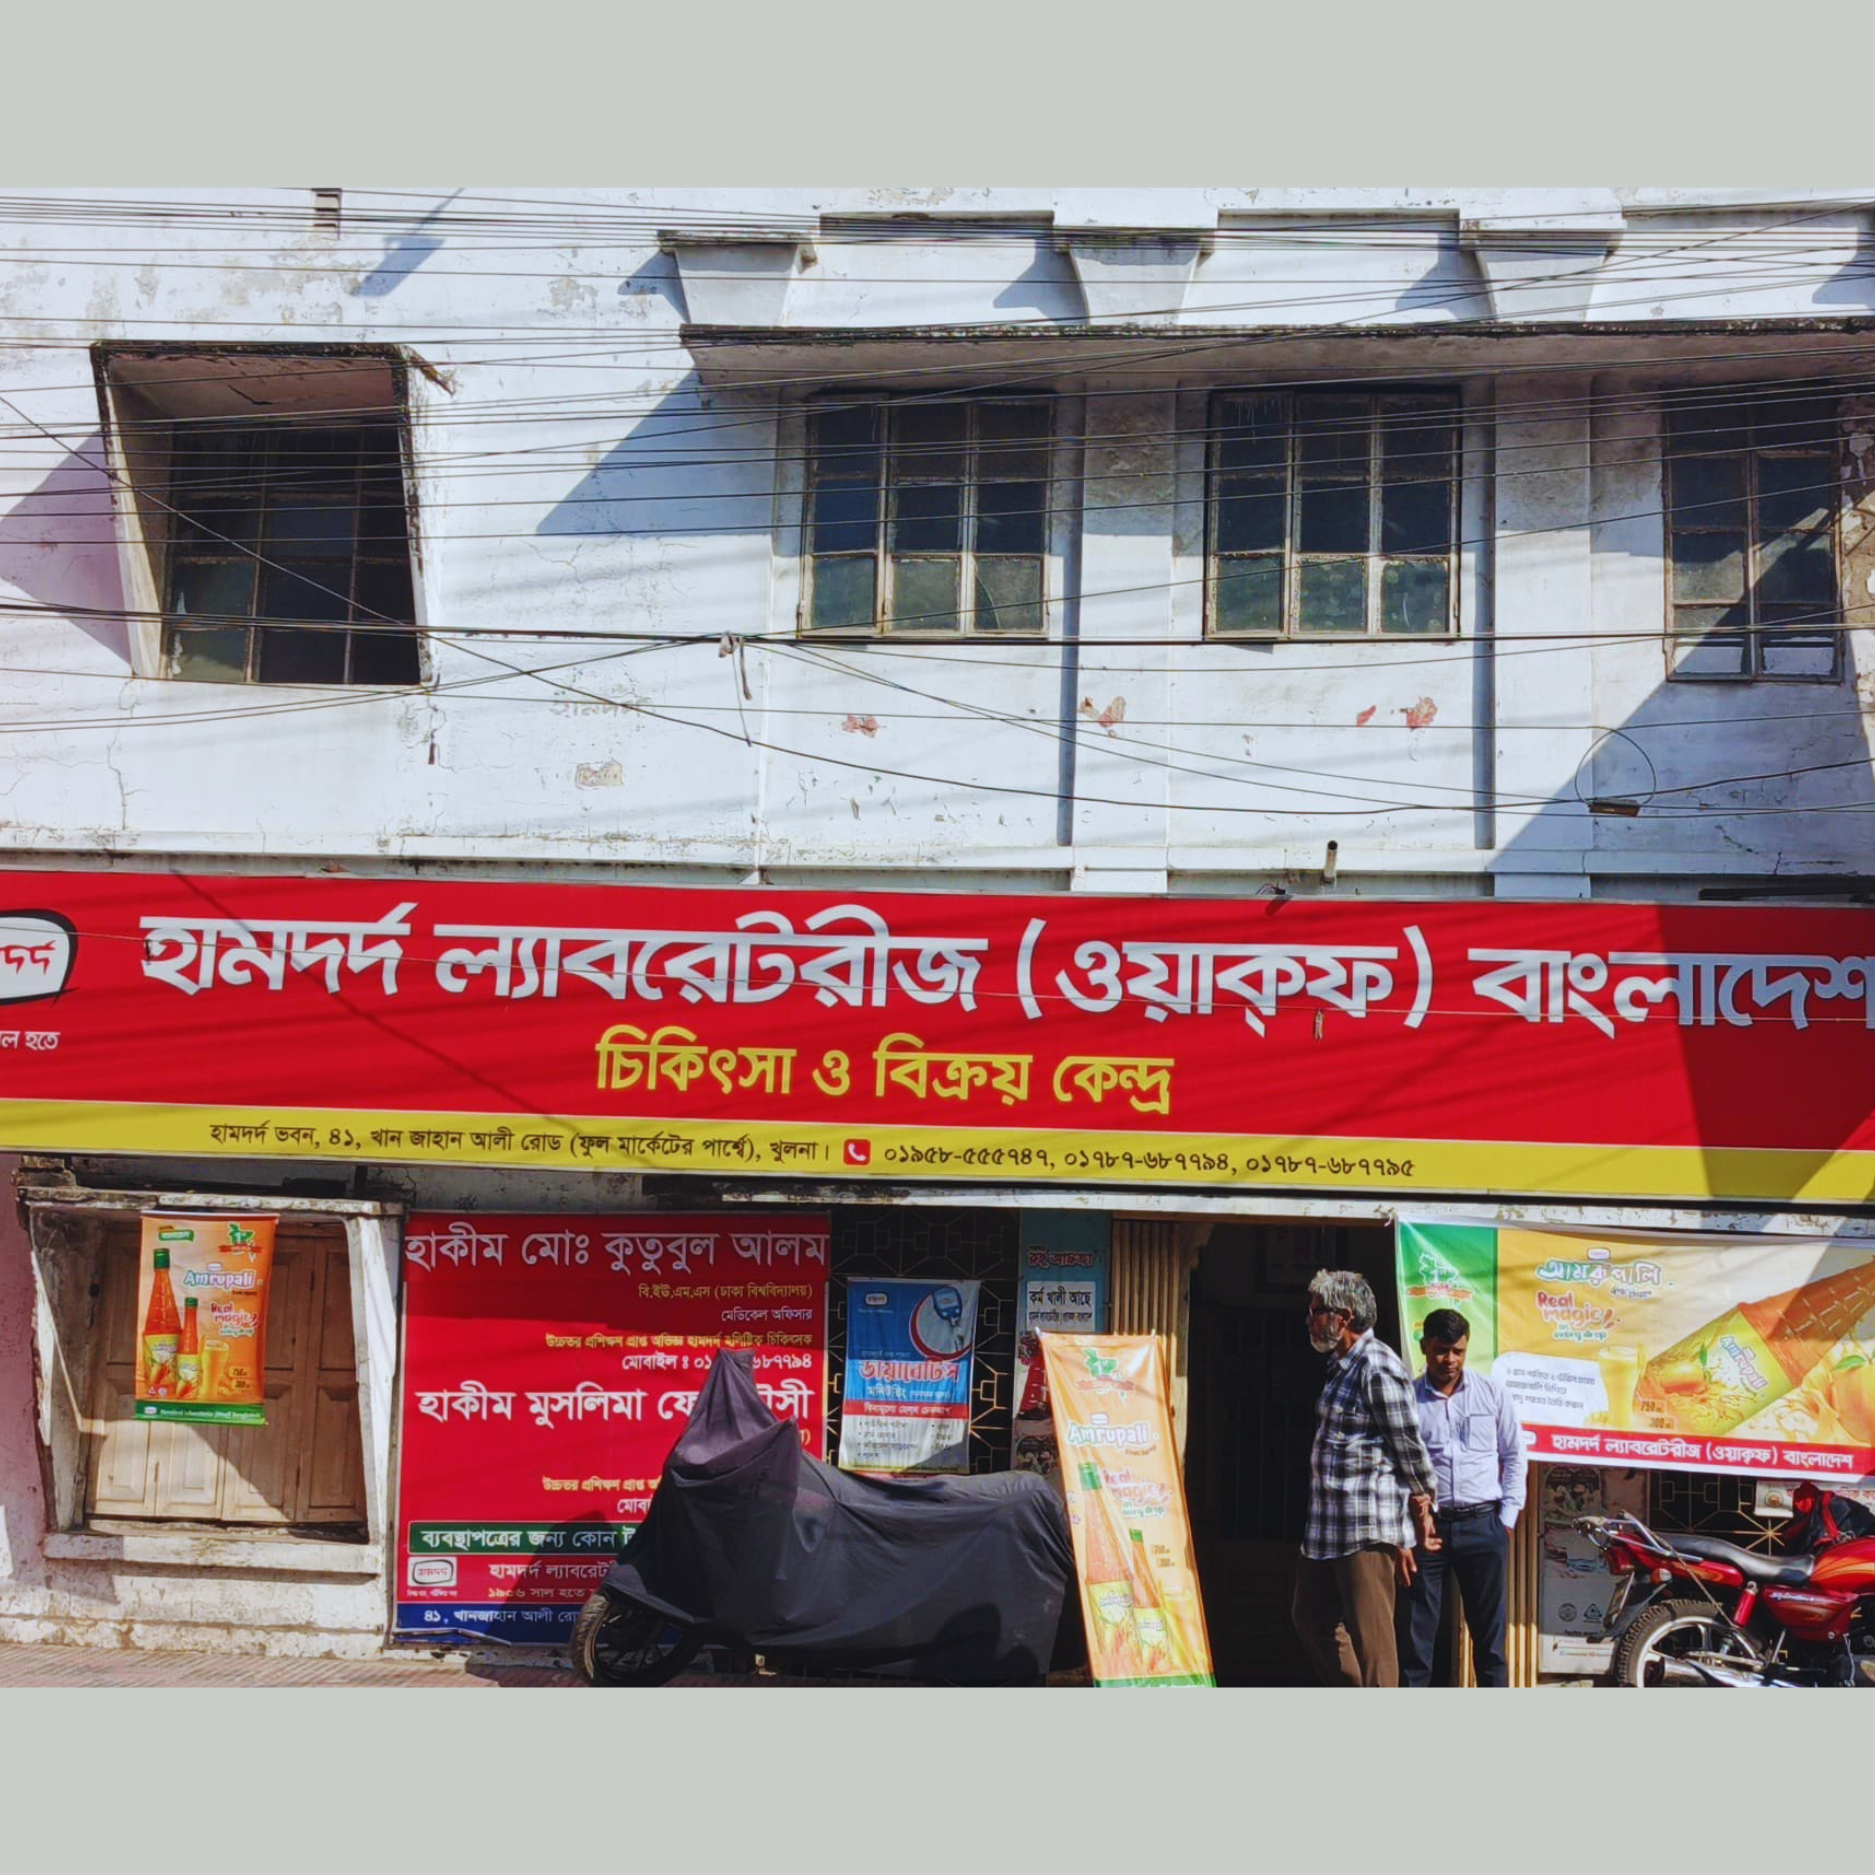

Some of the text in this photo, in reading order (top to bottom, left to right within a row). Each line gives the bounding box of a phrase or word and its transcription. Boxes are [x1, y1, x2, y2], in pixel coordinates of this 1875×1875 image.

[140, 902, 418, 996] হামদর্দ
[434, 904, 989, 1013] ল্যাবরেটরীজ
[1468, 948, 1875, 1040] বাংলাদেশ
[25, 1031, 61, 1051] হতে
[595, 1024, 1175, 1115] চিকিৎসা ও বিক্রয় কেন্দ্র
[209, 1120, 271, 1144] হামদর্দ
[275, 1126, 320, 1149] ভবন,
[329, 1128, 361, 1150] ৪১,
[371, 1128, 402, 1149] খান
[409, 1129, 465, 1151] জাহান
[470, 1126, 515, 1151] আলী
[521, 1132, 564, 1152] রোড
[570, 1133, 611, 1159] (ফুল
[618, 1131, 695, 1158] মার্কেটের
[884, 1145, 1055, 1170] ০১৯৫৮-৫৫৫৭৪৭,
[1064, 1149, 1237, 1176] ০১৭৮৭-৬৮৭৭৯৪,
[1246, 1154, 1415, 1177] ০১৭৮৭-৬৮৭৭৯৫
[405, 1220, 830, 1276] হাকীম মোঃ কুতুবুল আলম
[184, 1270, 254, 1288] Amrupali
[1538, 1291, 1573, 1307] Real
[721, 1306, 813, 1322] মেডিকেল অফিসার
[622, 1349, 678, 1370] মোবাইল
[416, 1380, 517, 1422] হাকীম
[525, 1381, 648, 1429] মুসলিমা
[1068, 1422, 1149, 1448] Amrupali
[1552, 1433, 1600, 1451] হামদর্দ
[1604, 1437, 1701, 1459] ল্যাবরেটরীজ
[1784, 1450, 1854, 1470] বাংলাদেশ
[421, 1530, 523, 1552] ব্যবস্থাপত্রের
[526, 1531, 567, 1549] জন্য
[572, 1531, 617, 1549] কোন
[488, 1560, 542, 1579] হামদর্দ
[530, 1588, 554, 1598] সাল
[559, 1588, 586, 1598] হতে
[521, 1607, 553, 1623] আলী
